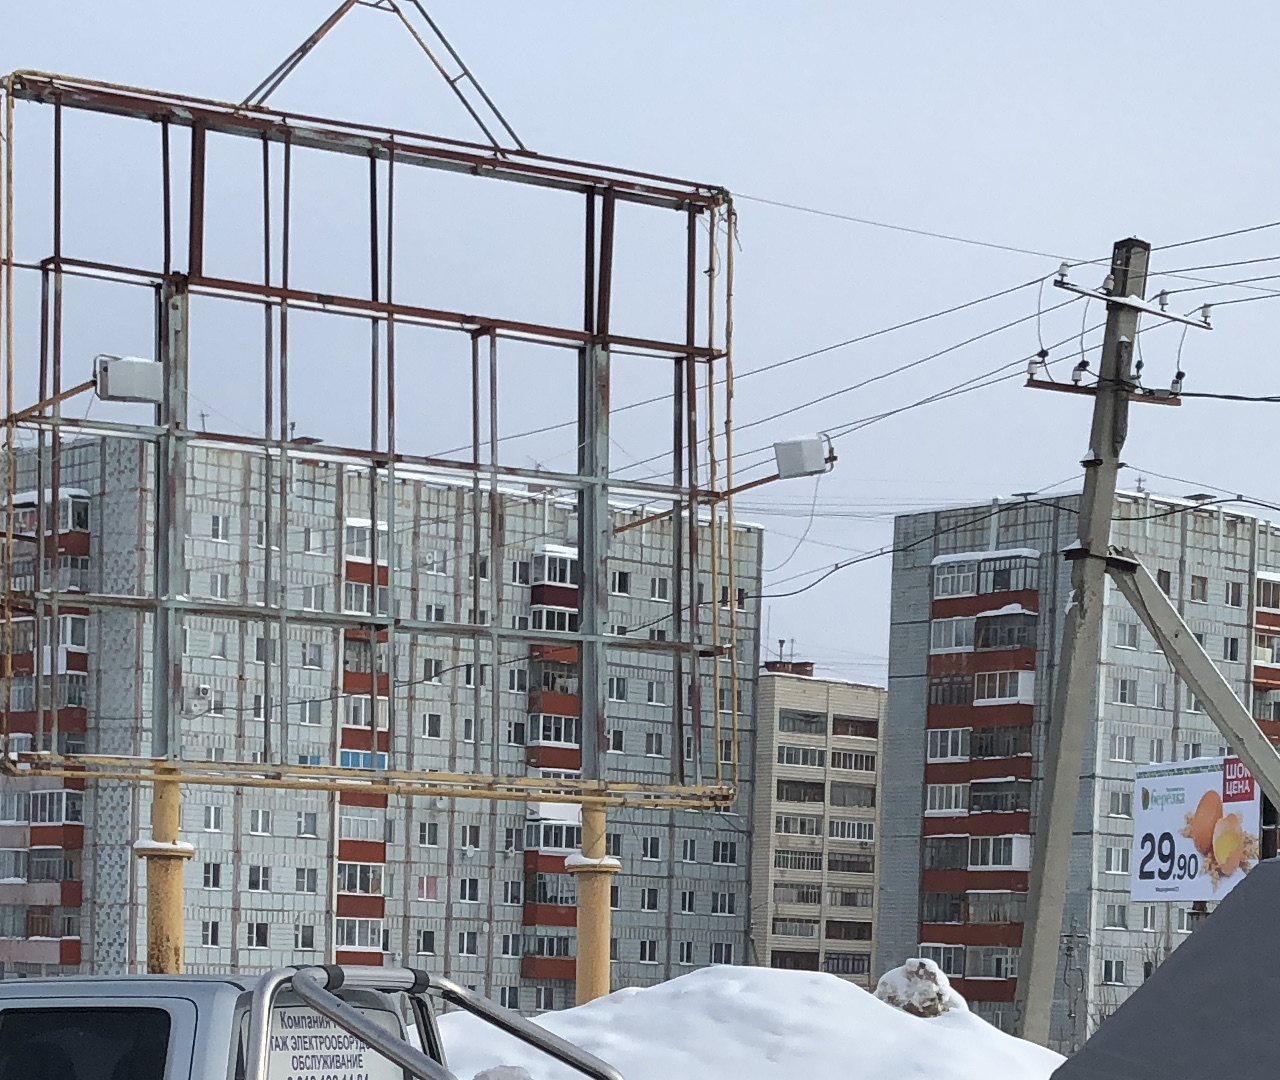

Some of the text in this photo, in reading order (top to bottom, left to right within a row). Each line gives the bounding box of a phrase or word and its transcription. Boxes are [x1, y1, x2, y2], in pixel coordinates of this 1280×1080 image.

[1226, 780, 1251, 797] ЦЕНА
[280, 1011, 331, 1029] Компания
[292, 1054, 364, 1070] ОБСЛУЖИВАНИЕ
